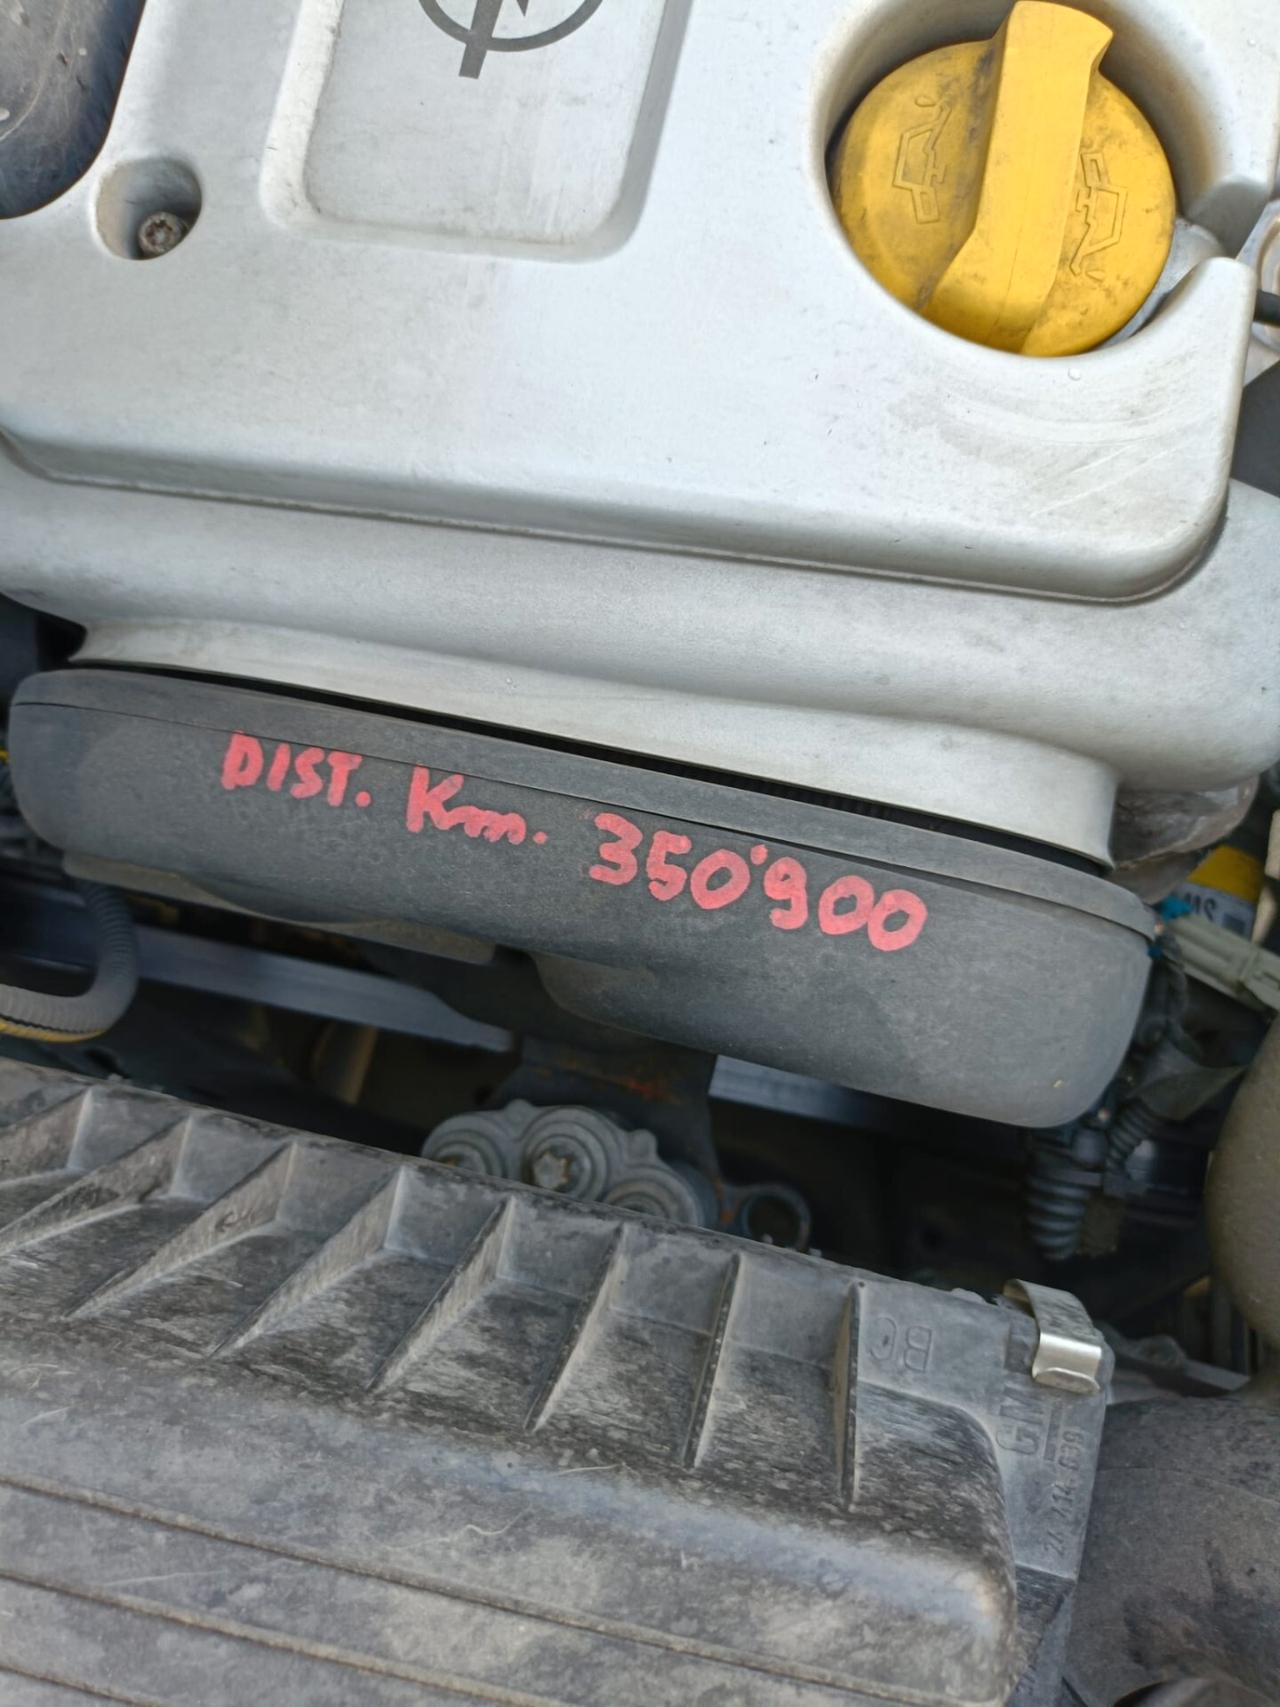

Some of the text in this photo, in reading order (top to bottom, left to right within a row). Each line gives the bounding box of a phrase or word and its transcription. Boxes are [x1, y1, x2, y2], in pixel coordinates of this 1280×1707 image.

[222, 731, 371, 808] DIST.
[407, 766, 547, 844] Km.
[869, 1317, 932, 1374] BC
[996, 1386, 1044, 1455] GM
